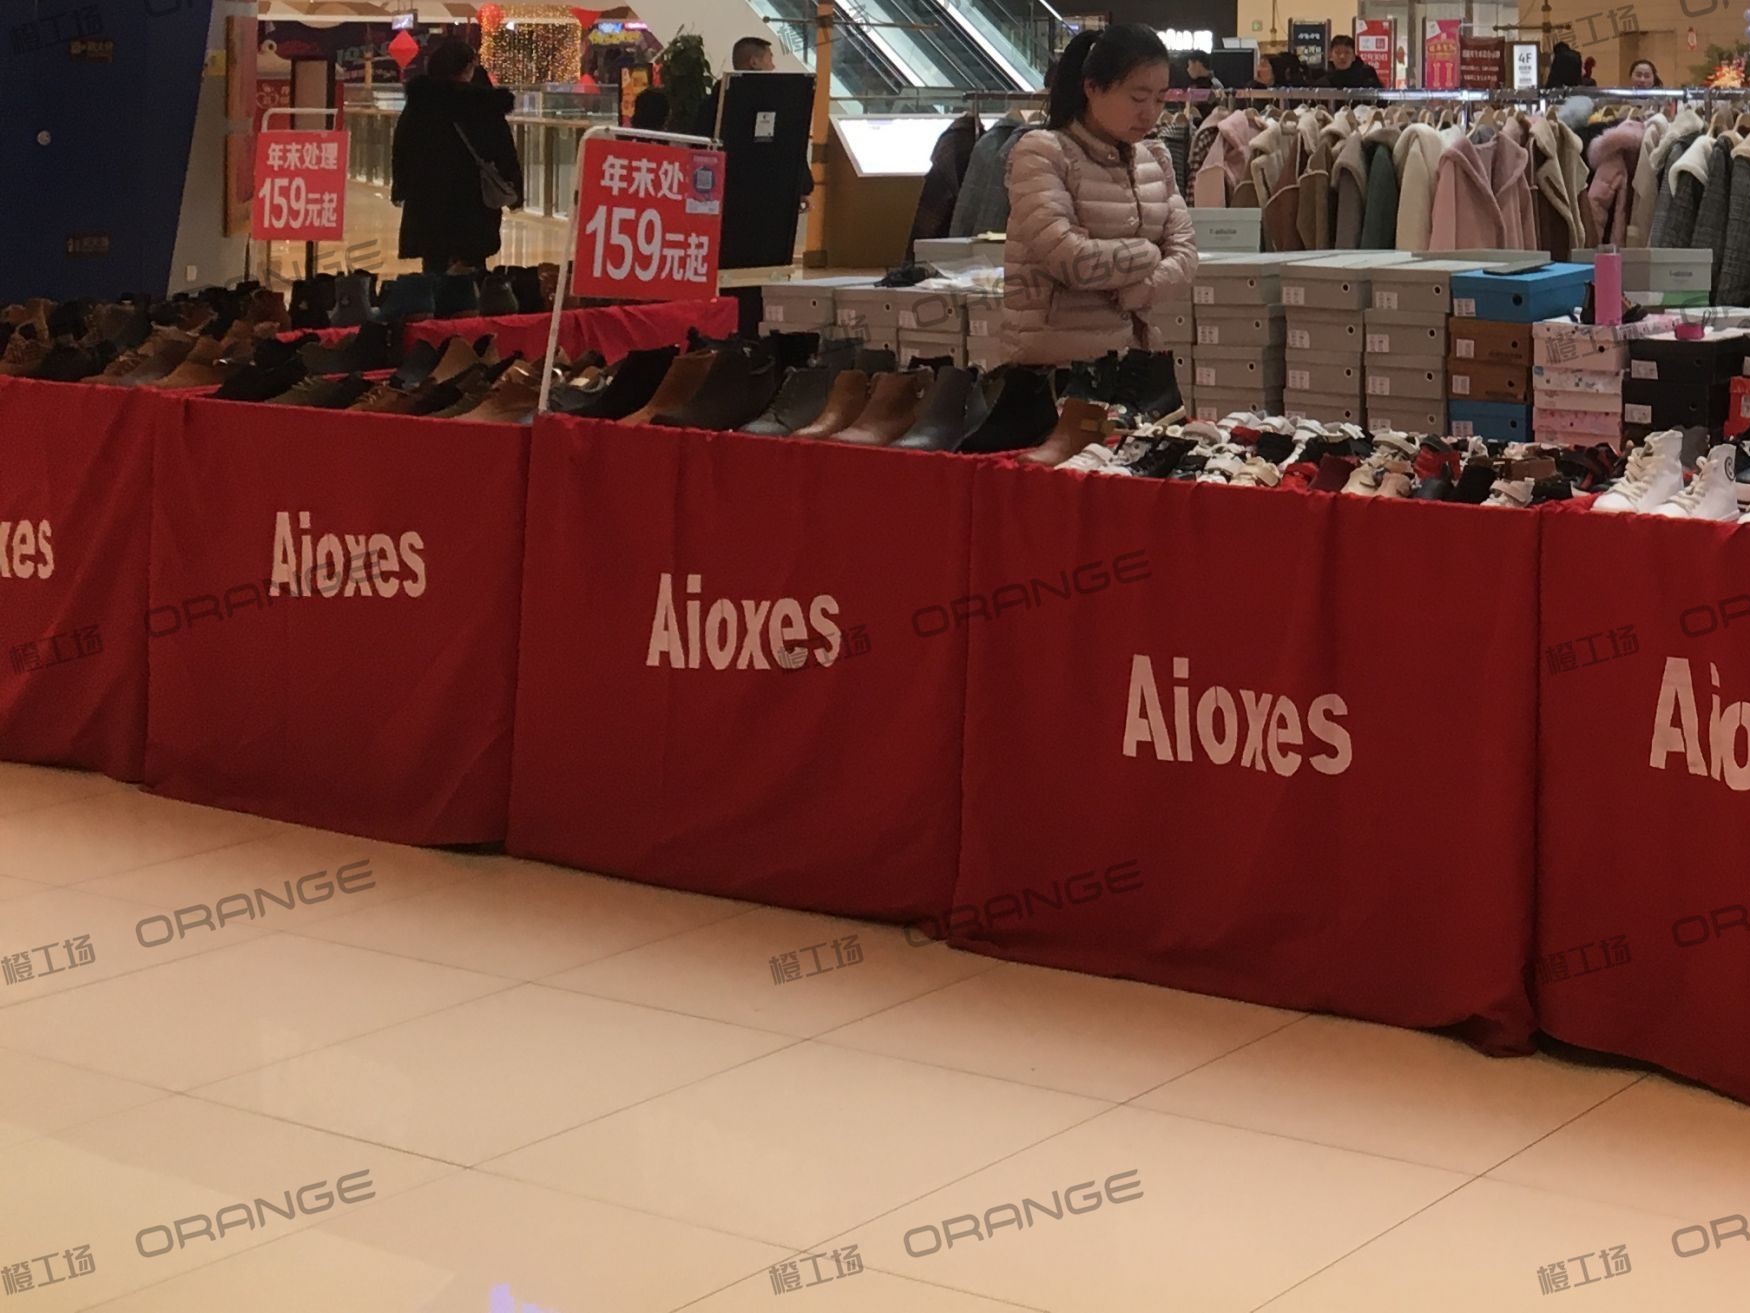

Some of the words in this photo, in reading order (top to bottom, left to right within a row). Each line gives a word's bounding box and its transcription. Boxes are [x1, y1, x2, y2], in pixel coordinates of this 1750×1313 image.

[267, 141, 338, 171] 年末处理
[600, 155, 689, 201] 年末处
[258, 176, 337, 229] 159元起
[585, 204, 709, 284] 159元起
[269, 511, 427, 598] Aioxes
[646, 574, 842, 670] Aioxes
[1122, 654, 1354, 777] Aioxes
